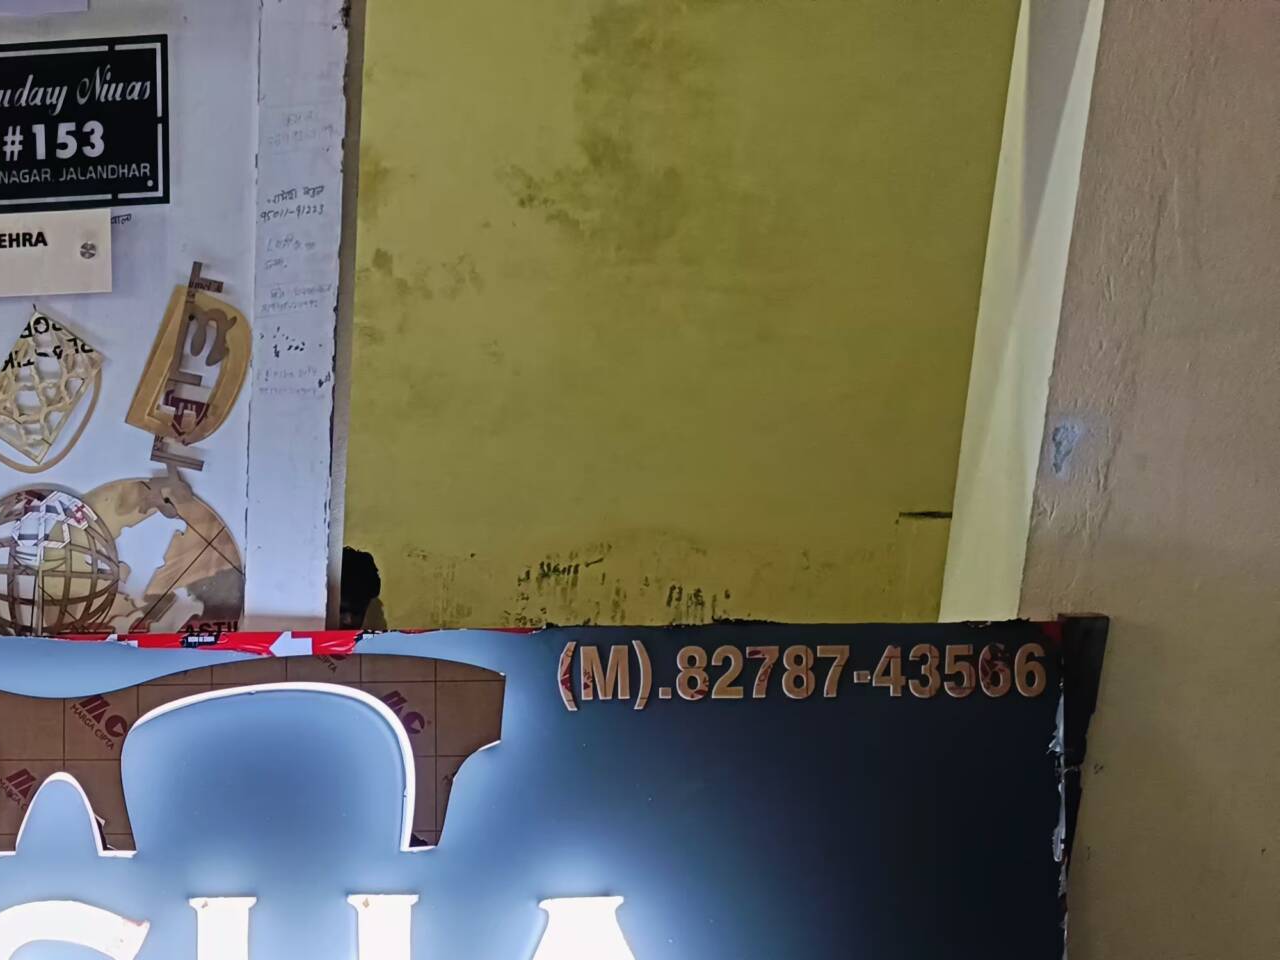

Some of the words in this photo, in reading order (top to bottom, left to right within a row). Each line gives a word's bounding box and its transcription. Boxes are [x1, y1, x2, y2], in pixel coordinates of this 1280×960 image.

[2, 120, 105, 161] #153
[58, 163, 151, 182] JALANDHAR
[556, 640, 1047, 711] (M).82787-43566
